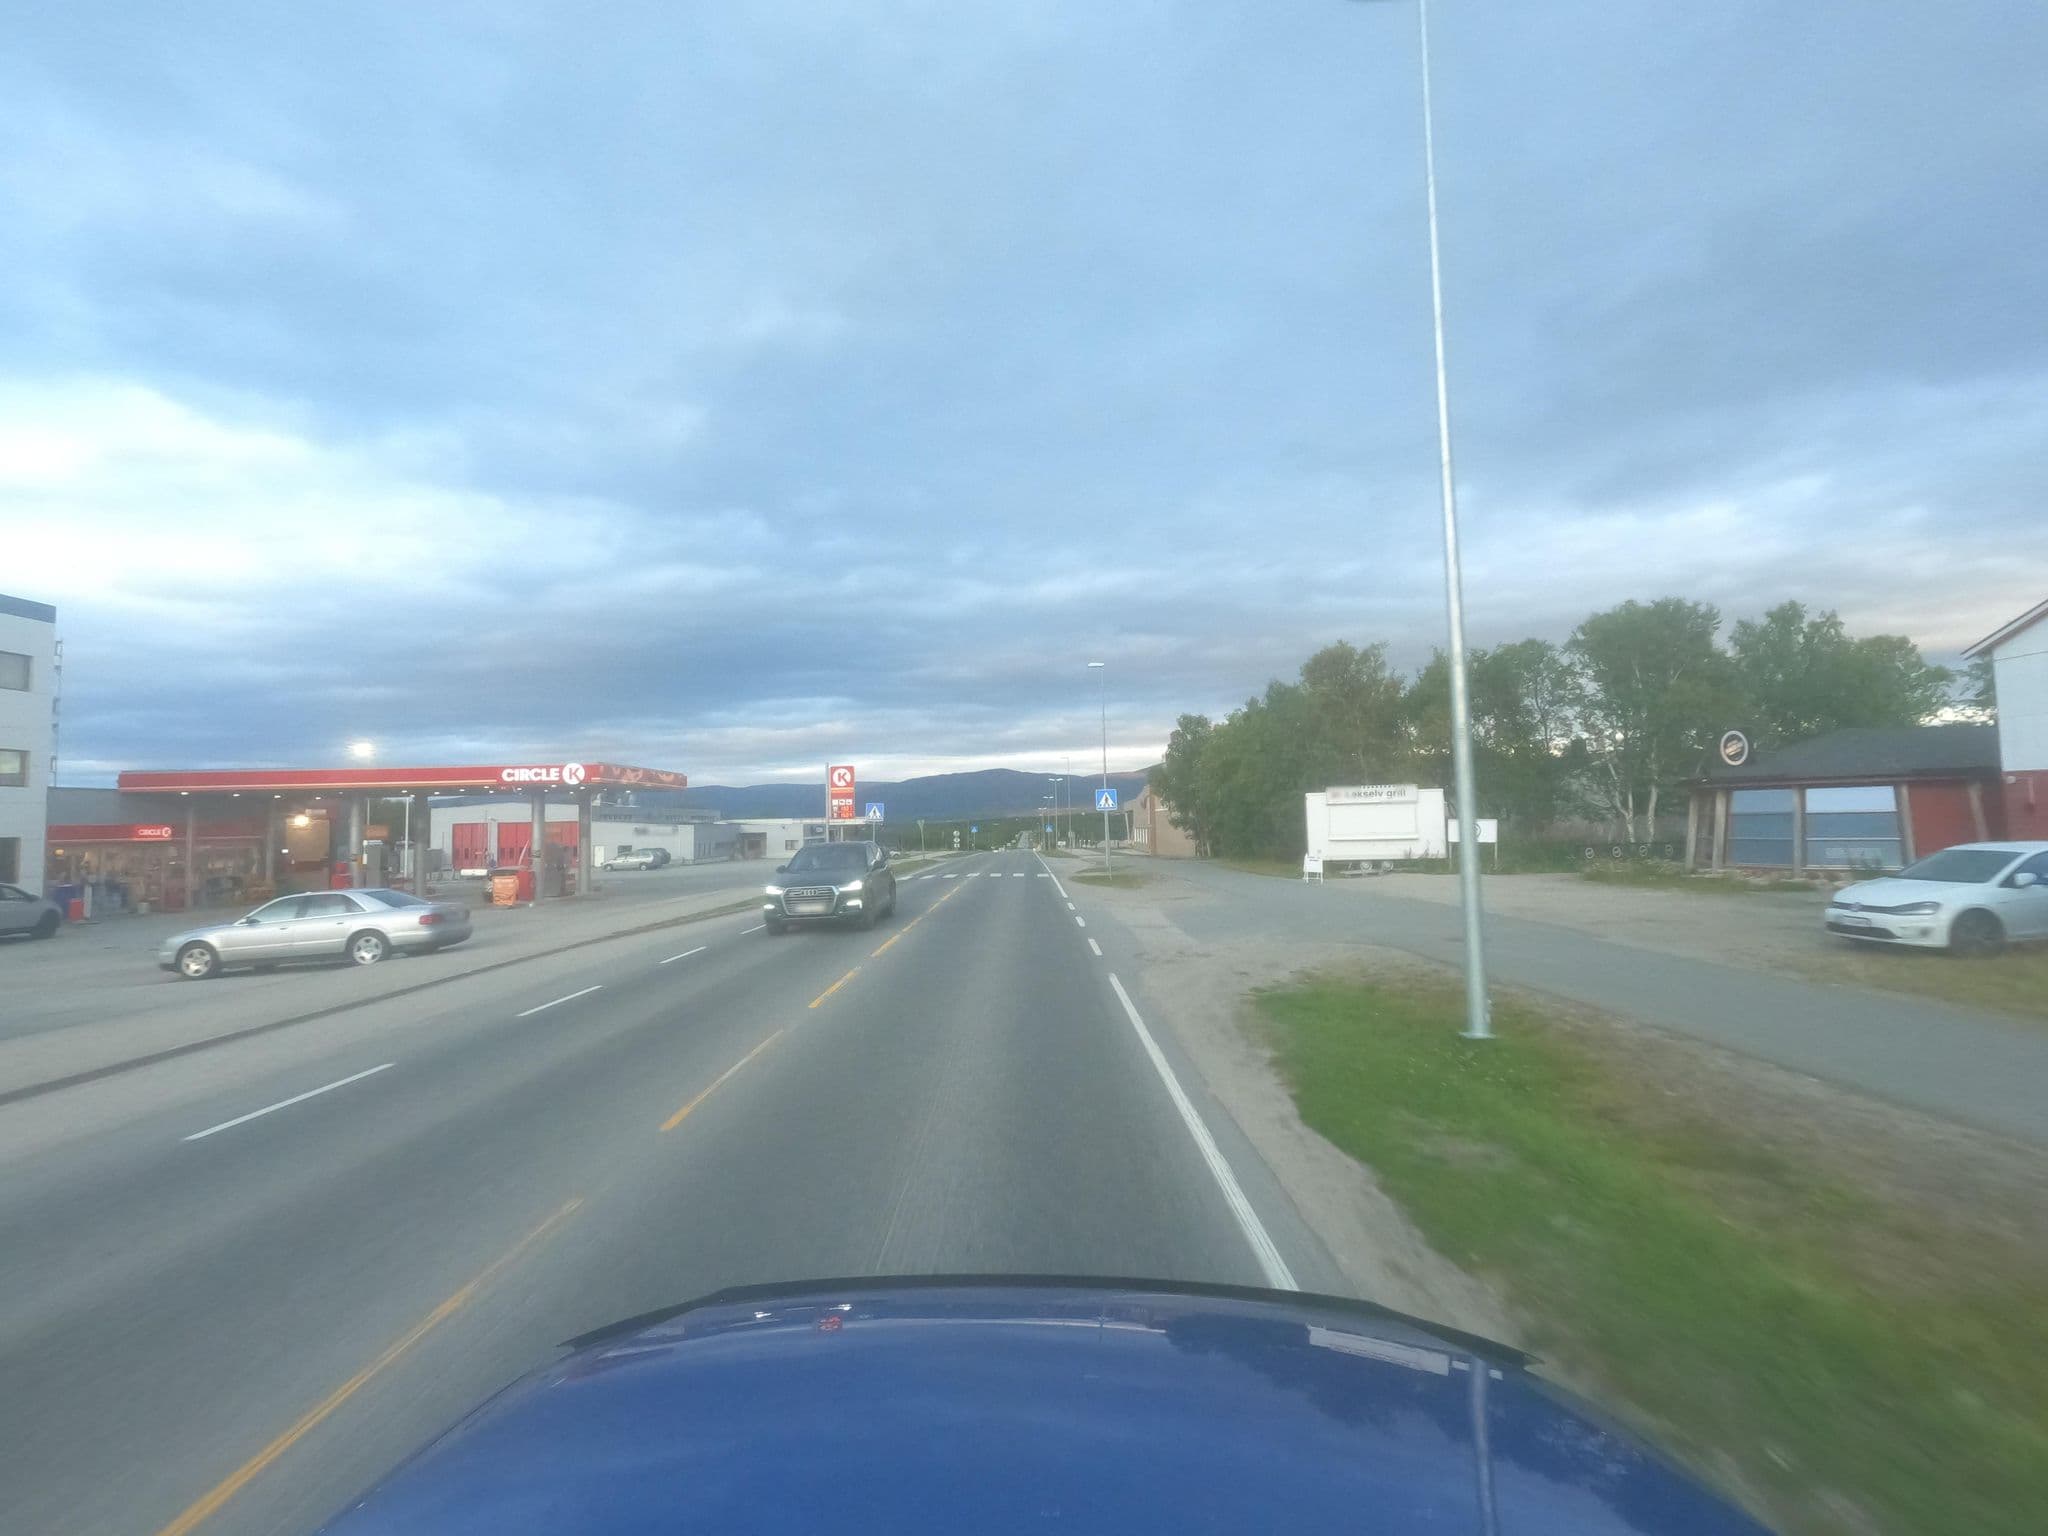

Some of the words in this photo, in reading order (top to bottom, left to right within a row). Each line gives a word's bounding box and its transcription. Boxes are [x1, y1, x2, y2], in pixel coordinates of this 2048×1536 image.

[501, 767, 560, 782] CIRCLE
[566, 765, 585, 784] K
[836, 771, 850, 786] K
[1386, 789, 1406, 799] grill
